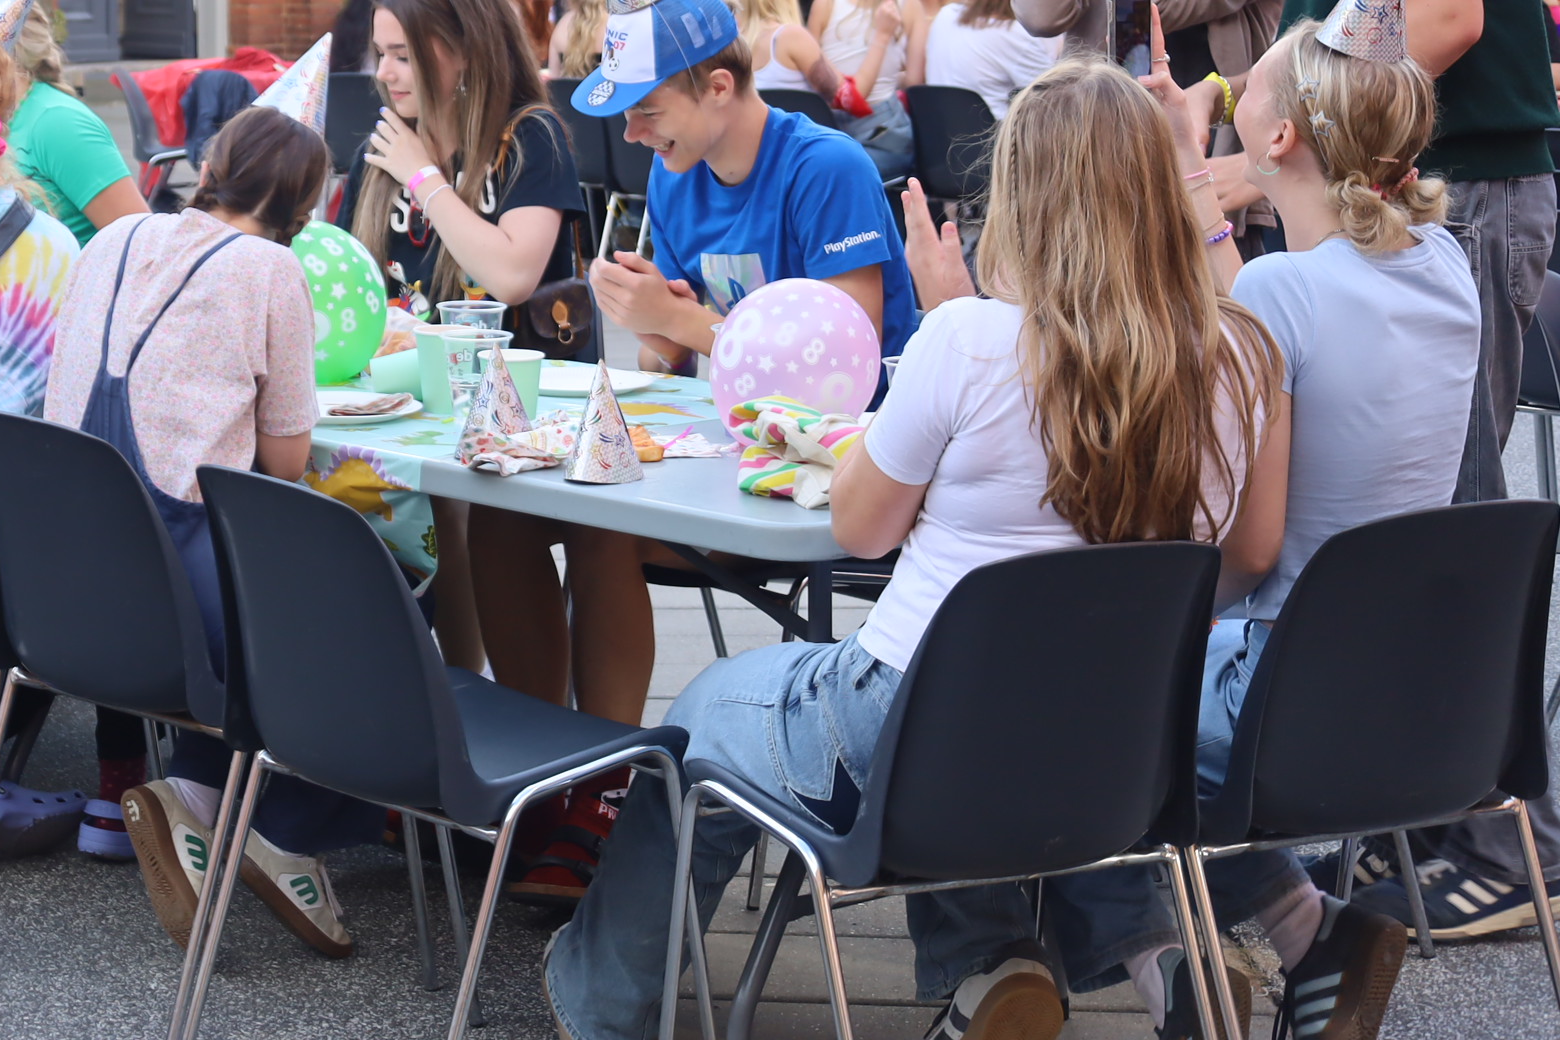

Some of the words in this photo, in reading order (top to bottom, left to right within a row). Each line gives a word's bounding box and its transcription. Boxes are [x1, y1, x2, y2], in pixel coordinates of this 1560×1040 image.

[605, 29, 628, 41] NIC
[613, 41, 626, 51] 07
[823, 230, 880, 255] PlayStation
[303, 253, 328, 277] 8
[341, 307, 357, 333] 8
[717, 307, 763, 371] 8
[801, 337, 826, 365] 8
[734, 372, 757, 398] 8
